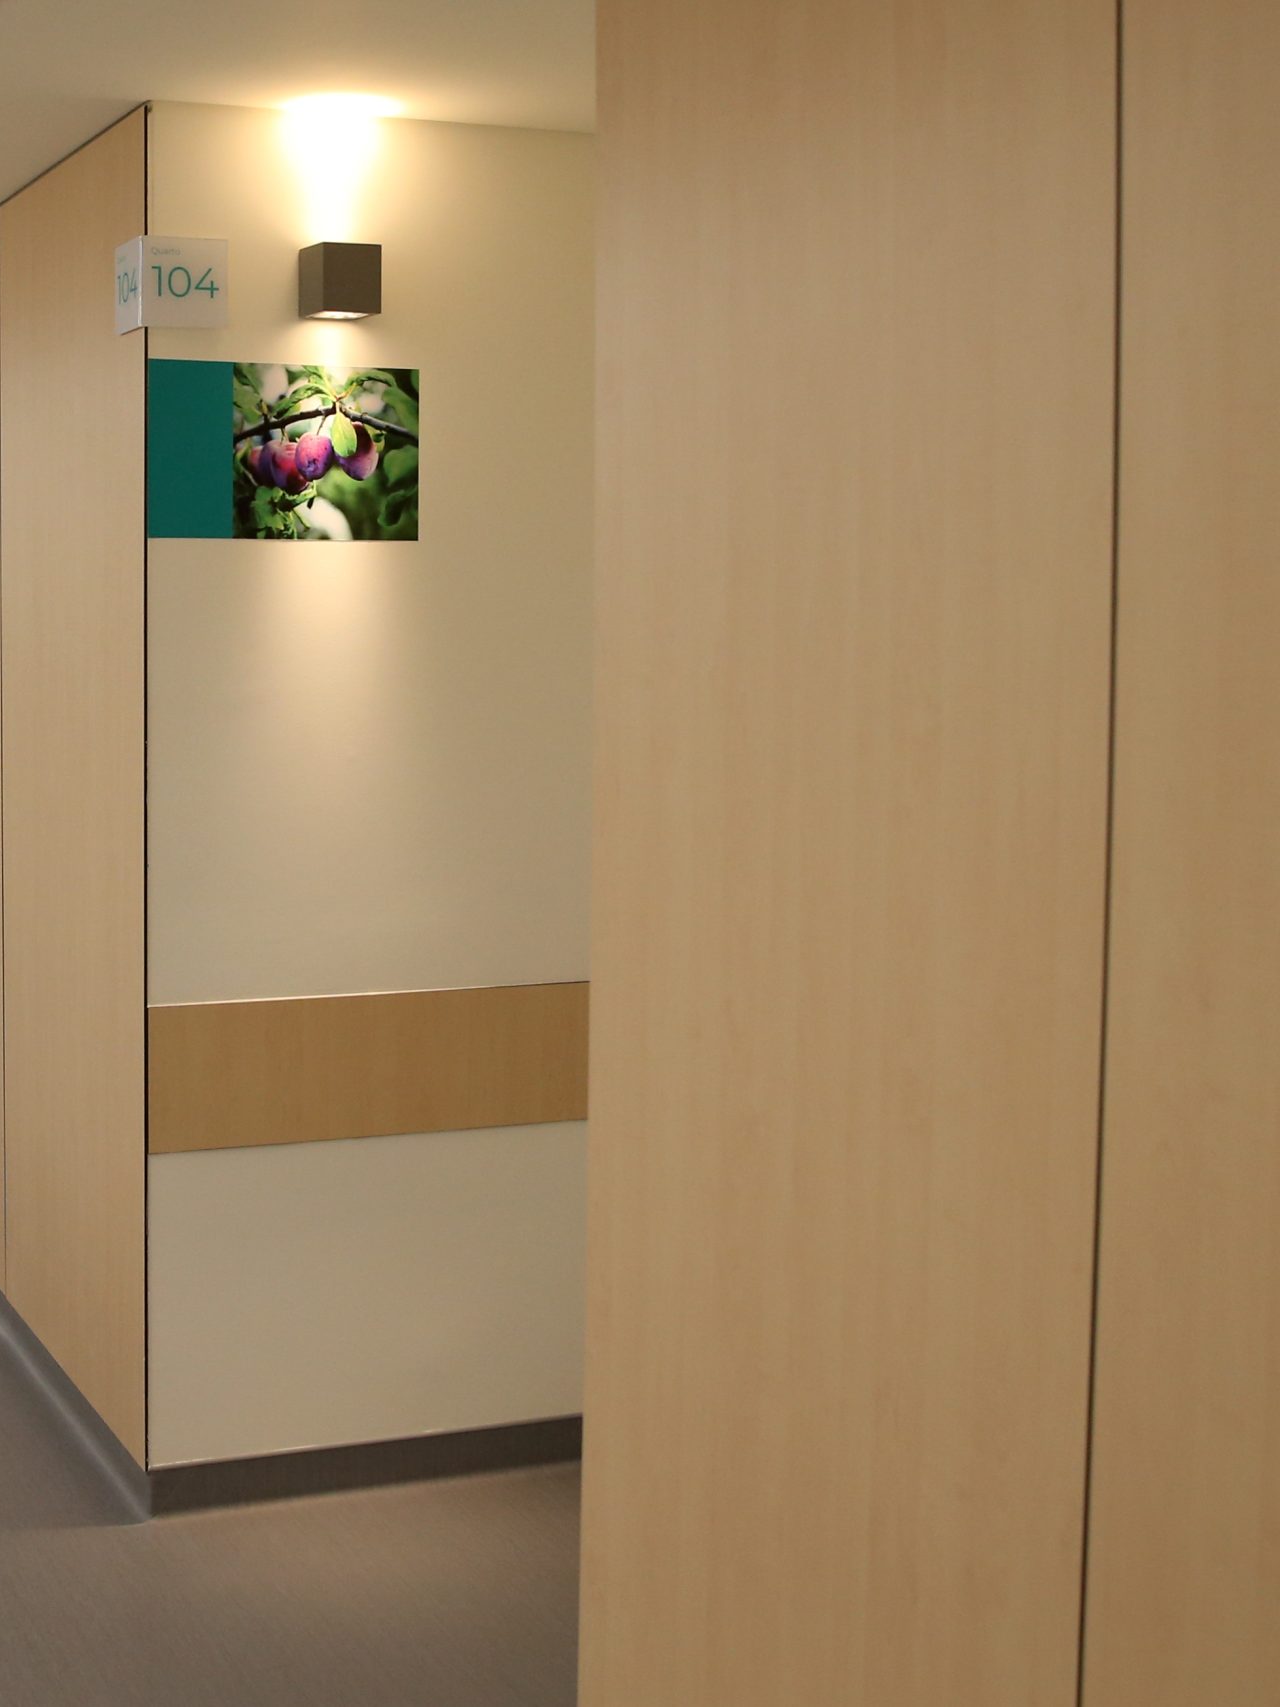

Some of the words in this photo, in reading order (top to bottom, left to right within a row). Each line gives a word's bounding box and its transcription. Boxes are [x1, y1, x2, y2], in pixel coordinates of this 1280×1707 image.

[151, 246, 182, 256] Quarto
[117, 268, 138, 305] 104
[151, 265, 219, 298] 104
